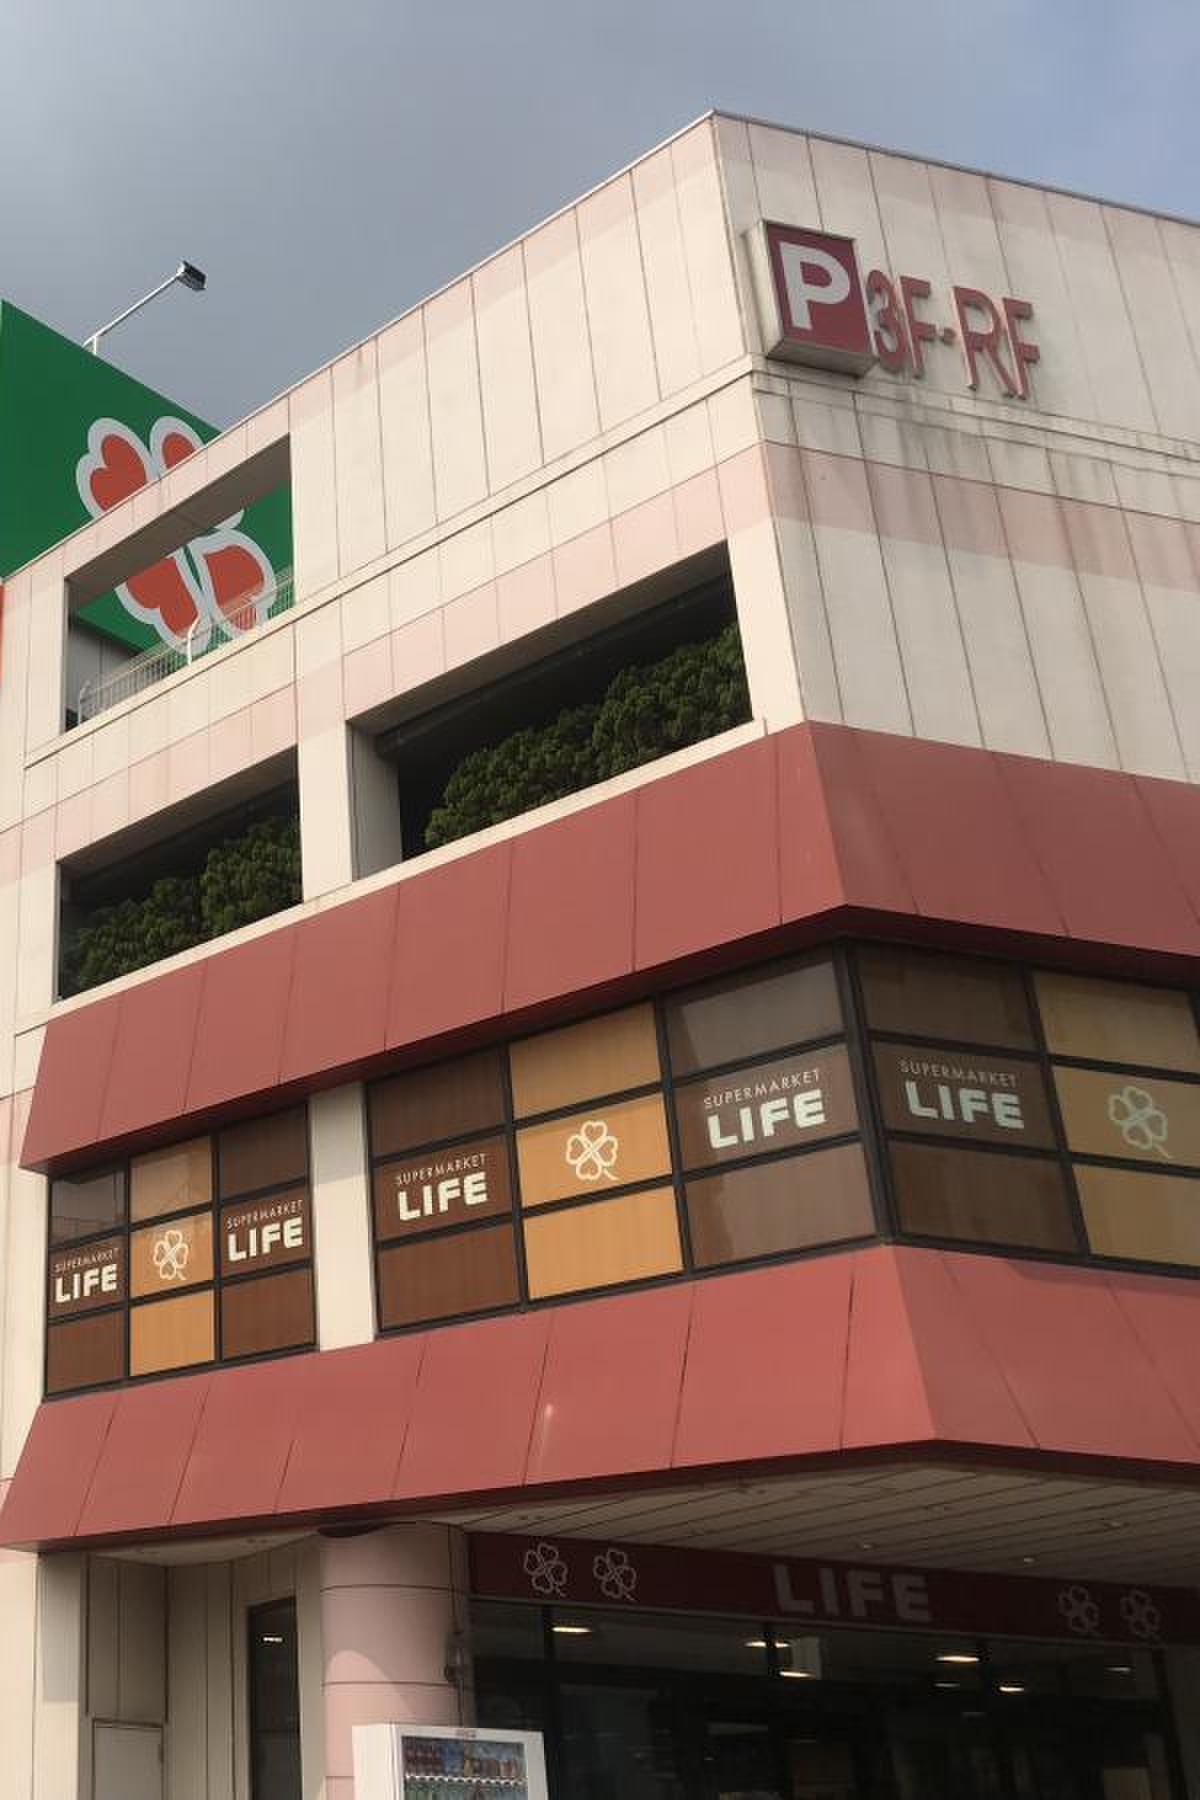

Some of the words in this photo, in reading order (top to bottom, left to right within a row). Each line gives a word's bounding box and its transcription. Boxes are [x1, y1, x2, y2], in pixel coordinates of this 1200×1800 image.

[779, 241, 850, 330] P
[703, 1067, 820, 1110] SUPERMARKET
[900, 1059, 1017, 1088] SUPERMARKET
[707, 1088, 826, 1149] LIFE
[905, 1080, 1025, 1129] LIFE
[395, 1153, 486, 1185] SUPERMARKET
[226, 1199, 303, 1230] SUPERMARKET
[398, 1171, 488, 1221] LIFE
[227, 1216, 304, 1262] LIFE
[55, 1263, 118, 1303] LIFE
[772, 1563, 932, 1623] LIFE
